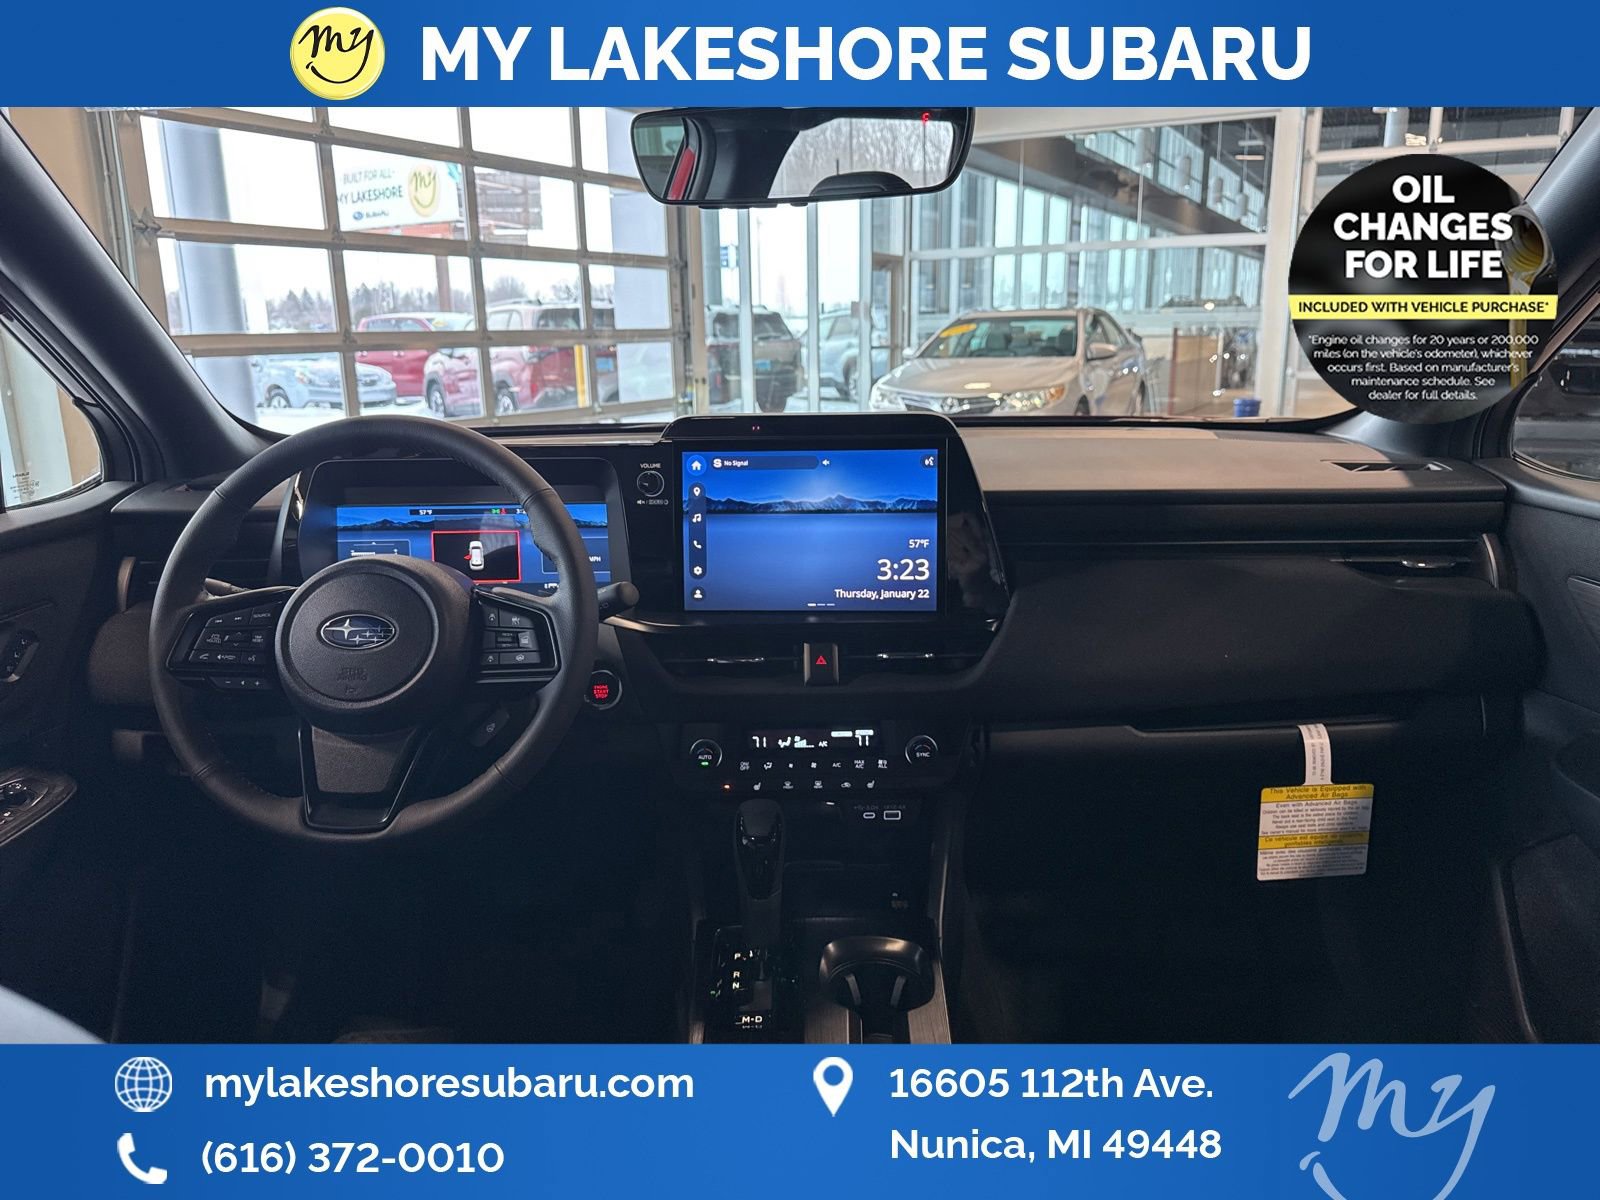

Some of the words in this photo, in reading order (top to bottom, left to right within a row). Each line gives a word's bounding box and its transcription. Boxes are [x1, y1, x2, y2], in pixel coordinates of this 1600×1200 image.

[351, 185, 403, 203] LAKESHORE
[734, 459, 749, 469] Signal
[908, 538, 930, 549] 57°F
[876, 558, 930, 581] 3:23
[834, 588, 879, 602] Thursday,
[880, 588, 915, 602] January
[917, 588, 930, 600] 22
[1320, 785, 1351, 794] Equipped
[1285, 792, 1318, 800] Advanced
[1332, 791, 1349, 799] Bags
[1305, 800, 1332, 808] Advanced
[734, 952, 741, 960] P
[733, 971, 740, 979] R
[732, 982, 740, 990] N
